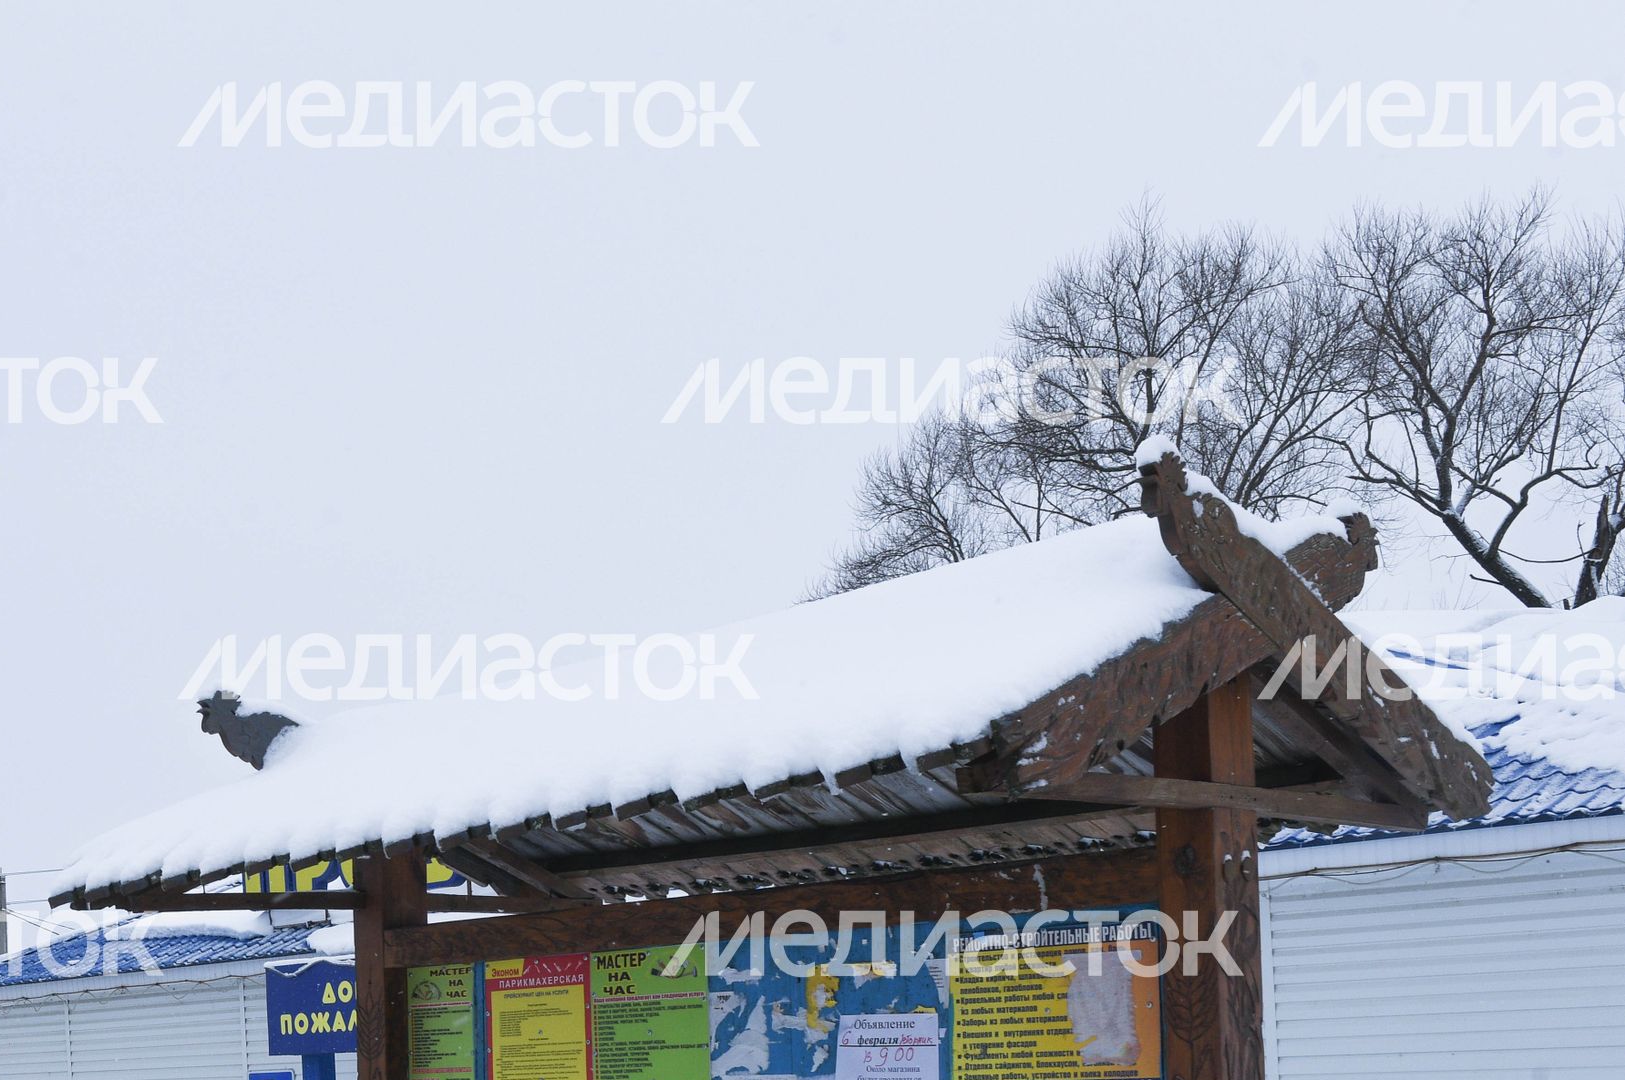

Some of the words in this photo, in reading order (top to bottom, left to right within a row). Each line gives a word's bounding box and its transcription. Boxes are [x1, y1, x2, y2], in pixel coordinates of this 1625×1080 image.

[1102, 923, 1151, 941] РАБОТЫ
[597, 952, 647, 970] МАСТЕР
[429, 967, 472, 977] МАСТЕР
[491, 968, 520, 977] Эконом
[608, 971, 631, 982] НА
[448, 979, 464, 987] НА
[499, 974, 584, 989] ПАРИКМАХЕРСКАЯ
[322, 980, 357, 1004] ДО
[446, 990, 467, 998] ЧАС
[603, 985, 636, 996] ЧАС
[854, 1019, 915, 1030] Объявление
[857, 1035, 898, 1046] февраля
[866, 1065, 886, 1073] Около
